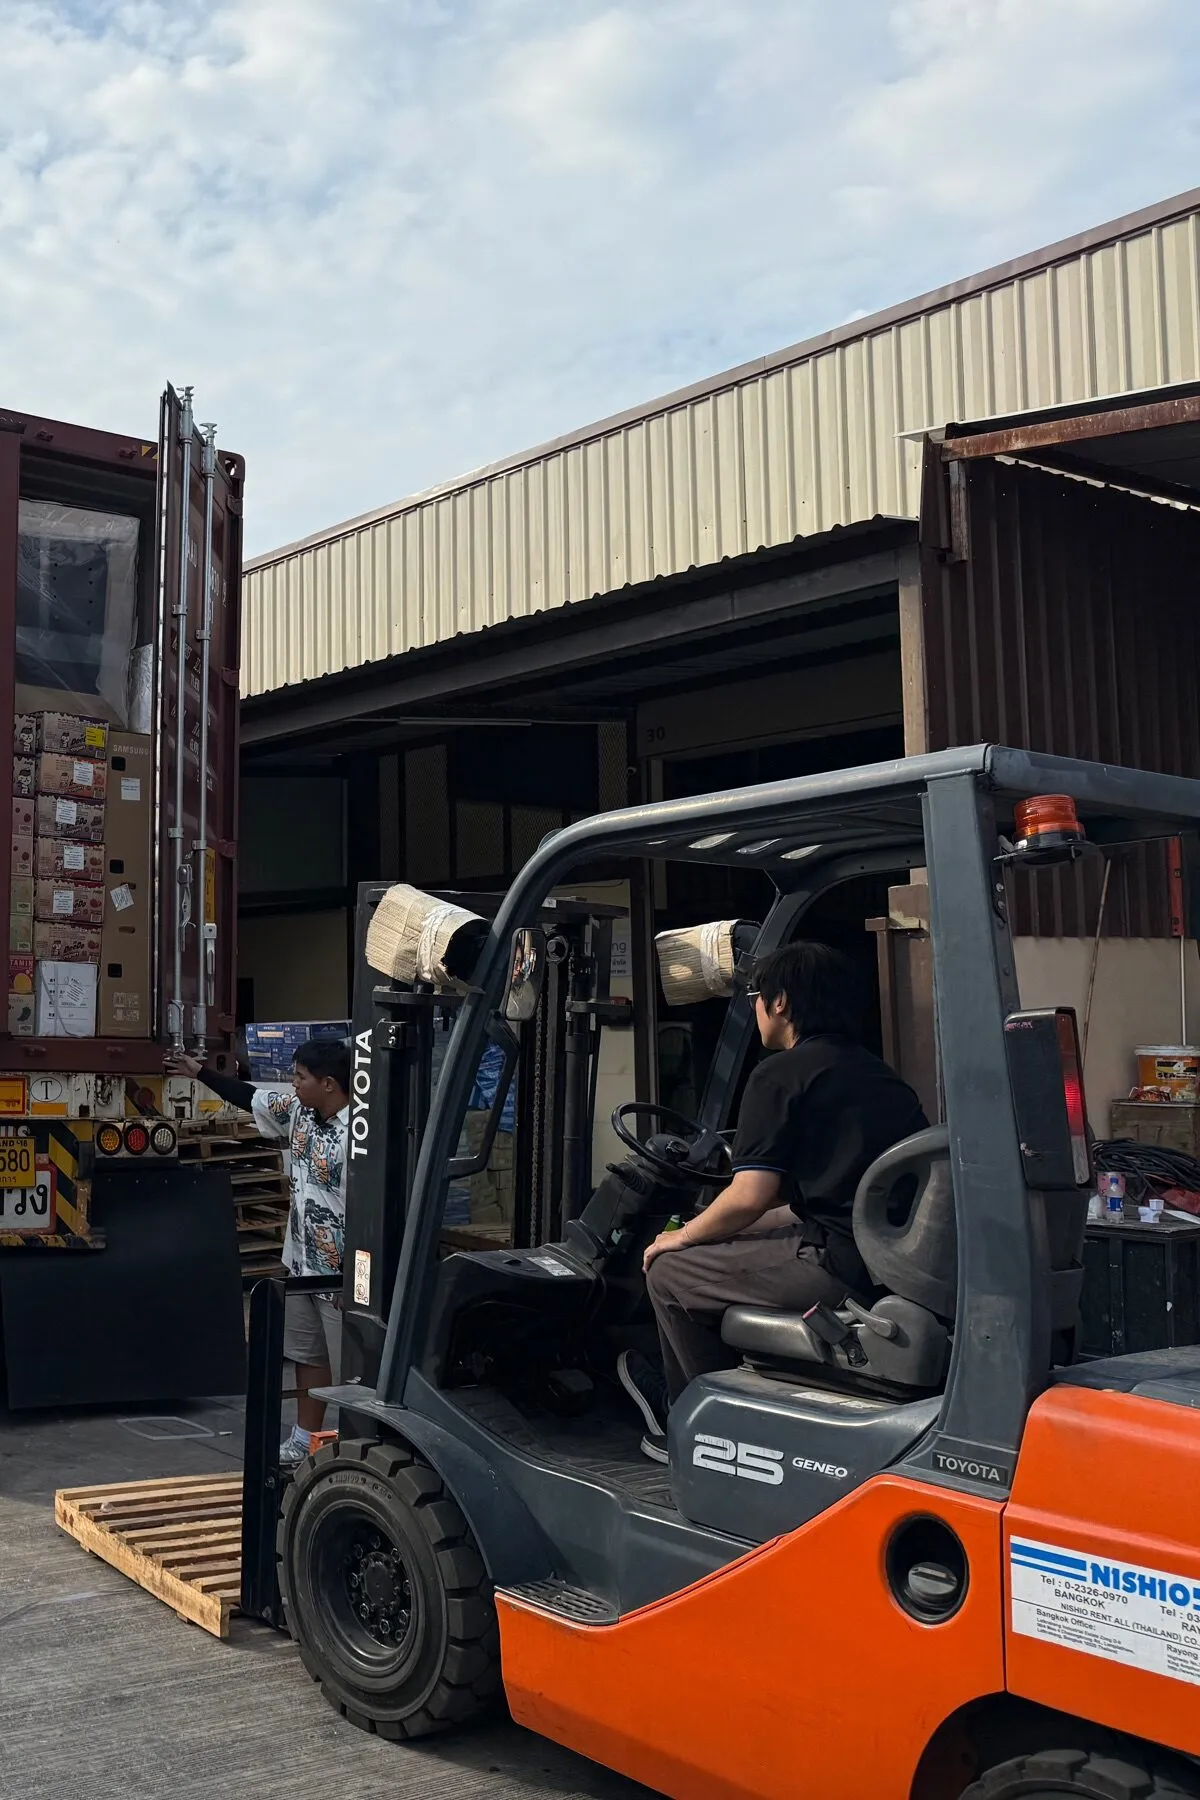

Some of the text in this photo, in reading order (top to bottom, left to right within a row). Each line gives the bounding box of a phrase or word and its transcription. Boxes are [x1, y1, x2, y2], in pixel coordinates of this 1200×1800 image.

[647, 726, 666, 743] 30
[113, 744, 149, 756] SAMSUNG
[40, 1080, 53, 1100] T
[351, 1028, 372, 1160] TOYOTA
[692, 1433, 848, 1485] 25 GENEO
[936, 1454, 1000, 1481] TOYOTA
[1040, 1574, 1055, 1586] Tel
[1064, 1581, 1129, 1605] 0-2326-0970
[1090, 1562, 1191, 1607] NISHIO
[1054, 1588, 1106, 1609] BANGKOK
[1036, 1608, 1069, 1623] Bangkok
[1160, 1605, 1176, 1616] Tel
[1060, 1603, 1089, 1616] NISHIO
[1090, 1610, 1112, 1622] RENT
[1114, 1617, 1131, 1628] ALL
[1132, 1622, 1182, 1642] (THAILAND)
[1166, 1643, 1199, 1660] Rayong
